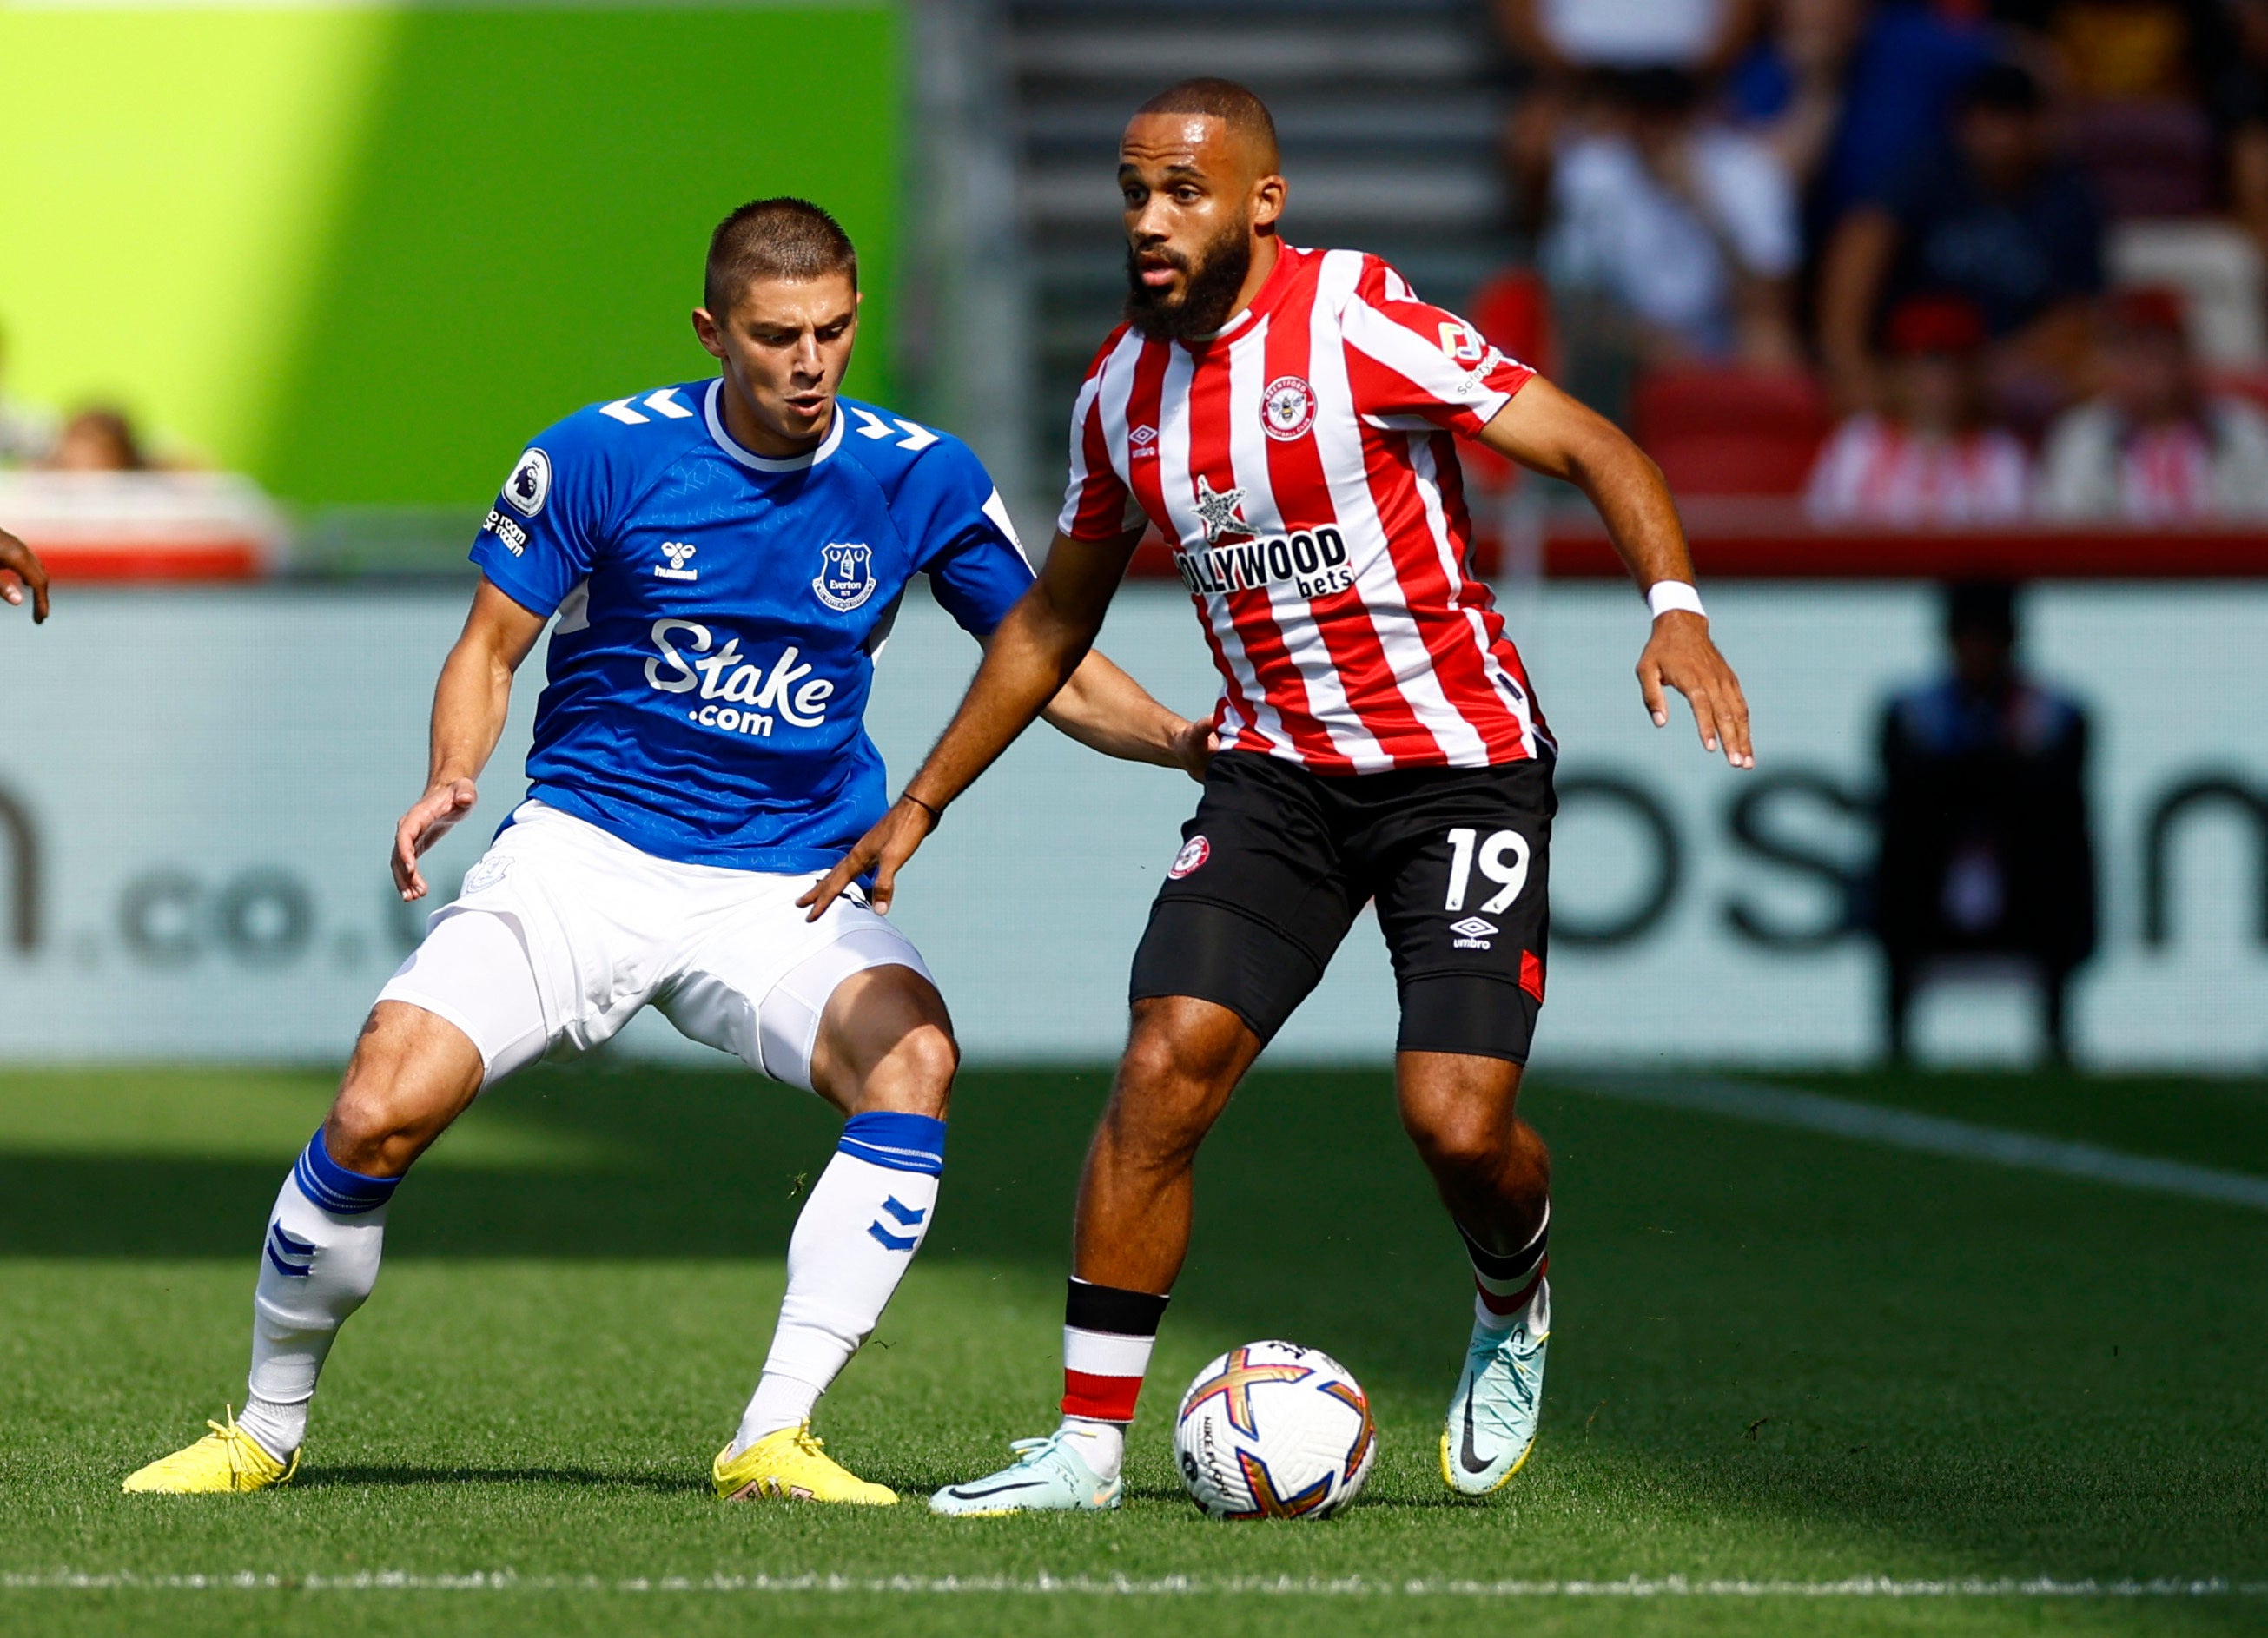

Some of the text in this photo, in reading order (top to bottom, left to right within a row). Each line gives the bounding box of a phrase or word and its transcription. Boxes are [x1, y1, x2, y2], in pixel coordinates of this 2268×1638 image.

[500, 515, 526, 545] room
[1174, 527, 1346, 595] OLLYWOOD
[830, 579, 862, 590] Everton
[1295, 569, 1353, 598] bets
[644, 618, 834, 728] Stake
[689, 704, 774, 737] .com
[1445, 828, 1531, 915] 19
[1453, 936, 1491, 951] umbro
[1204, 1416, 1214, 1447] NIKE
